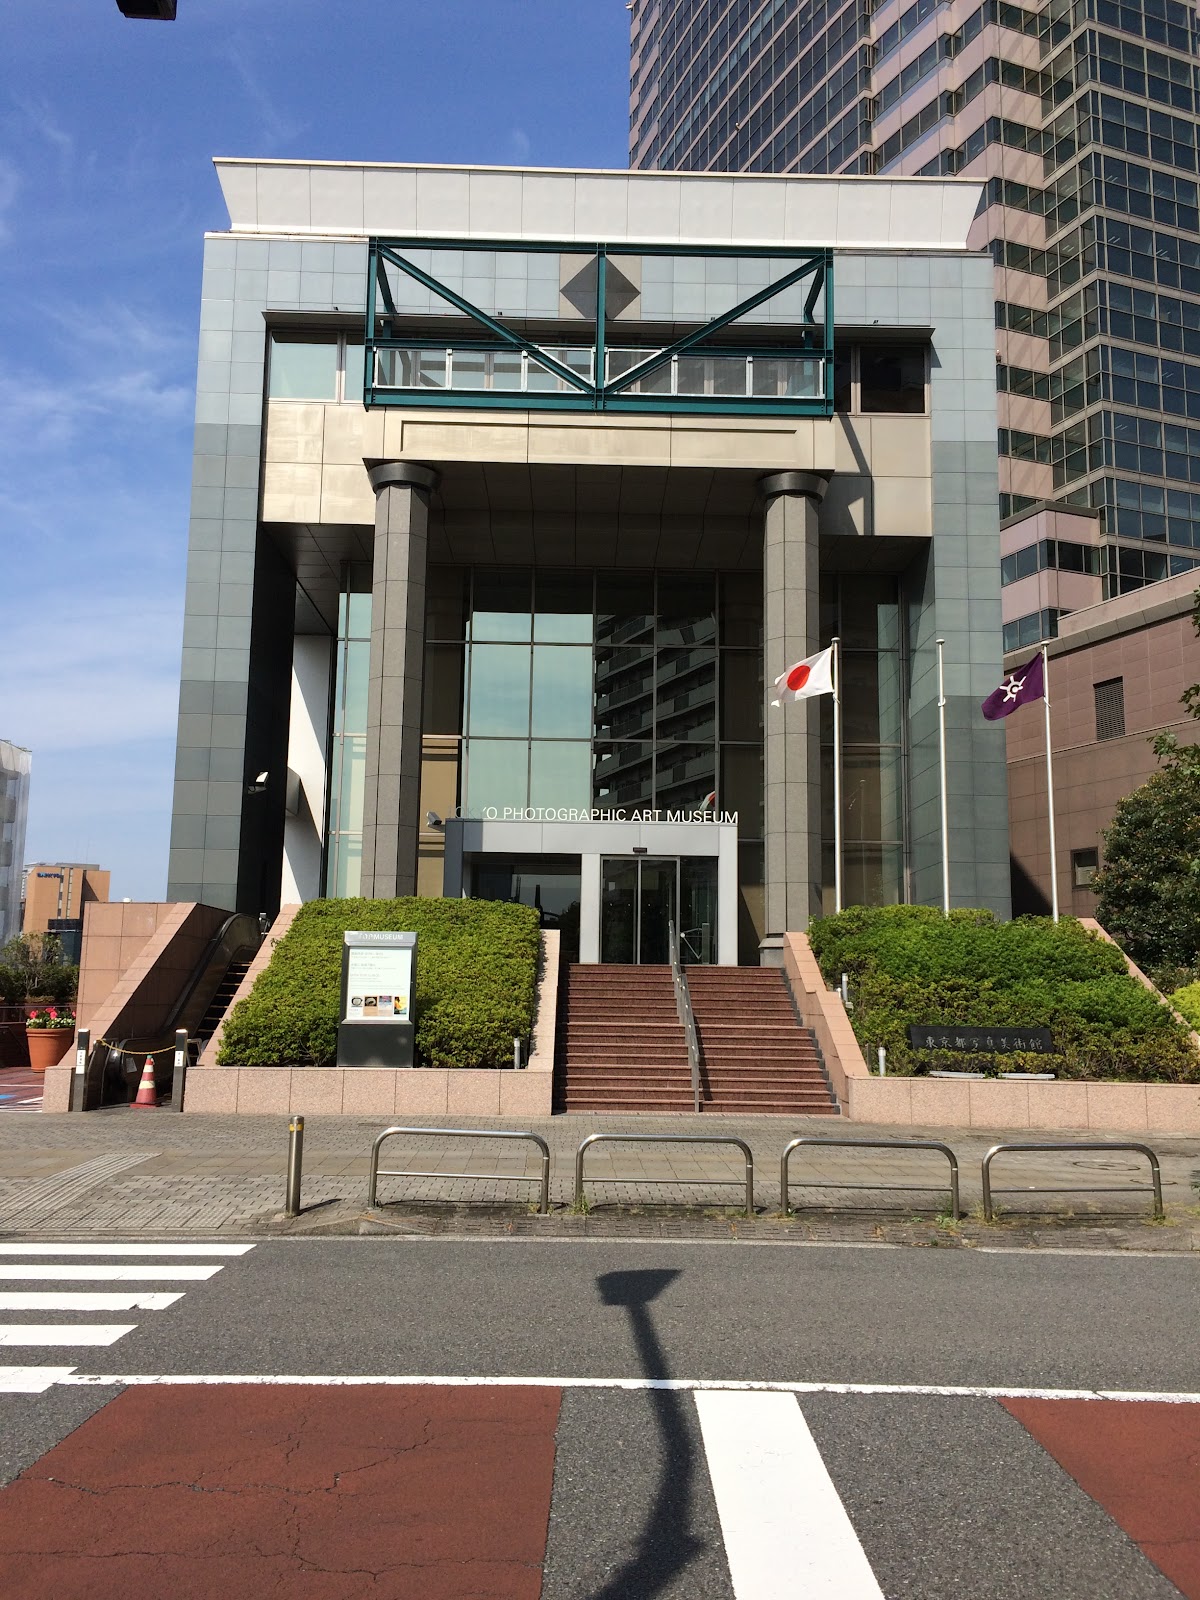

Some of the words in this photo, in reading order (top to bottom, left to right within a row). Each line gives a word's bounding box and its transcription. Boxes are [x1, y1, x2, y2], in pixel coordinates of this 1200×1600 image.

[503, 807, 627, 822] PHOTOGRAPHIC
[631, 809, 662, 822] ART
[667, 810, 738, 824] MUSEUM
